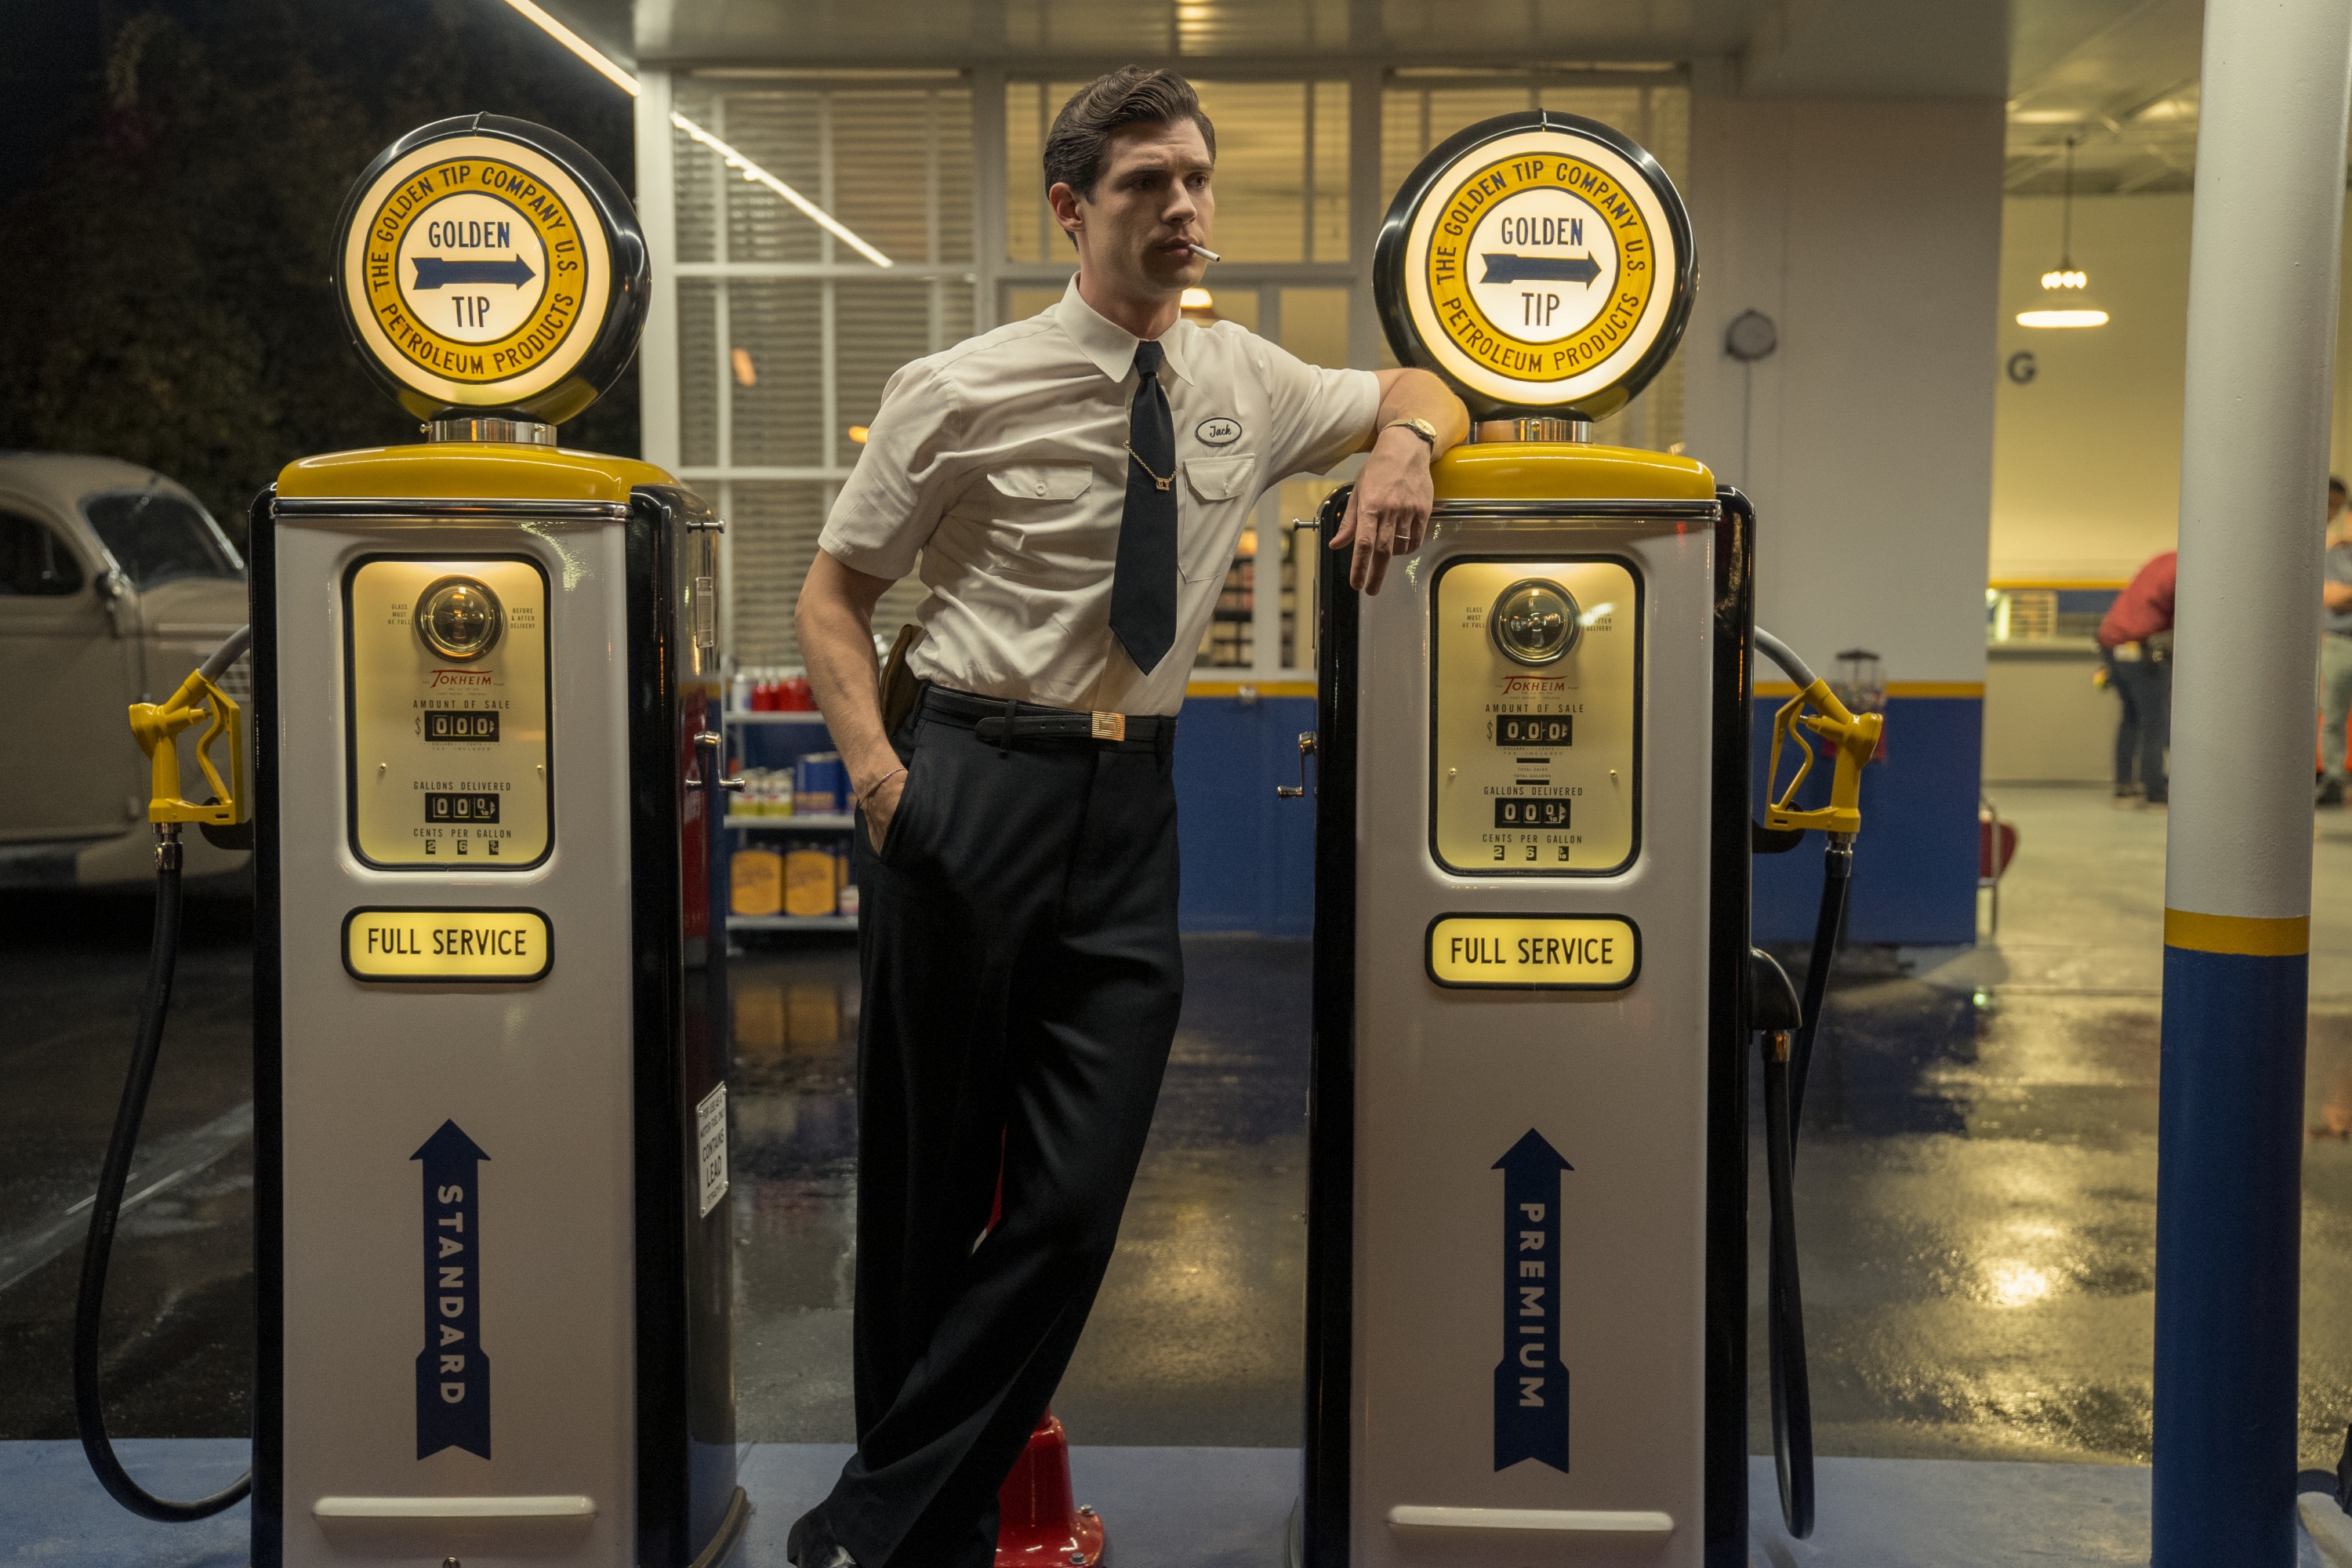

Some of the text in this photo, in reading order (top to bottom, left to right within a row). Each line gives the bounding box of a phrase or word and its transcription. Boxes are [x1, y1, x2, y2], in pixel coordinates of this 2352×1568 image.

[372, 165, 579, 292] THE GOLDEN TIP COMPANY U.S.
[429, 221, 510, 249] GOLDEN
[1436, 160, 1646, 285] THE GOLDEN TIP COMPANY U.S.
[1501, 217, 1583, 246] GOLDEN
[452, 296, 490, 328] TIP
[1521, 292, 1560, 326] TIP
[380, 293, 574, 375] PETROLEUM PRODUCTS
[1442, 292, 1639, 372] PETROLEUM PRODUCTS
[2007, 350, 2036, 385] G
[1210, 424, 1232, 437] Jack
[429, 670, 493, 688] TOKHEIM
[1501, 675, 1568, 695] TOKHEIM
[413, 700, 510, 710] AMOUNT OF SALE
[1486, 704, 1584, 713] AMOUNT OF SALE
[415, 715, 421, 737] $
[1486, 720, 1493, 742] $
[414, 782, 511, 791] GALLONS DELIVERED
[1484, 786, 1583, 796] GALLONS DELIVERED
[414, 828, 512, 838] CENTS PER GALLON
[426, 840, 436, 851] 2
[459, 840, 468, 851] 6
[1483, 834, 1512, 843] CENTS
[1547, 835, 1582, 844] GALLON
[1494, 847, 1503, 858] 2
[1526, 847, 1534, 858] 6
[368, 927, 527, 956] FULL SERVICE
[1451, 938, 1613, 965] FULL SERVICE
[702, 1128, 724, 1162] CONTAINS
[706, 1155, 722, 1189] LEAD
[437, 1185, 466, 1403] STANDARD
[1519, 1203, 1545, 1407] PREMIUM
